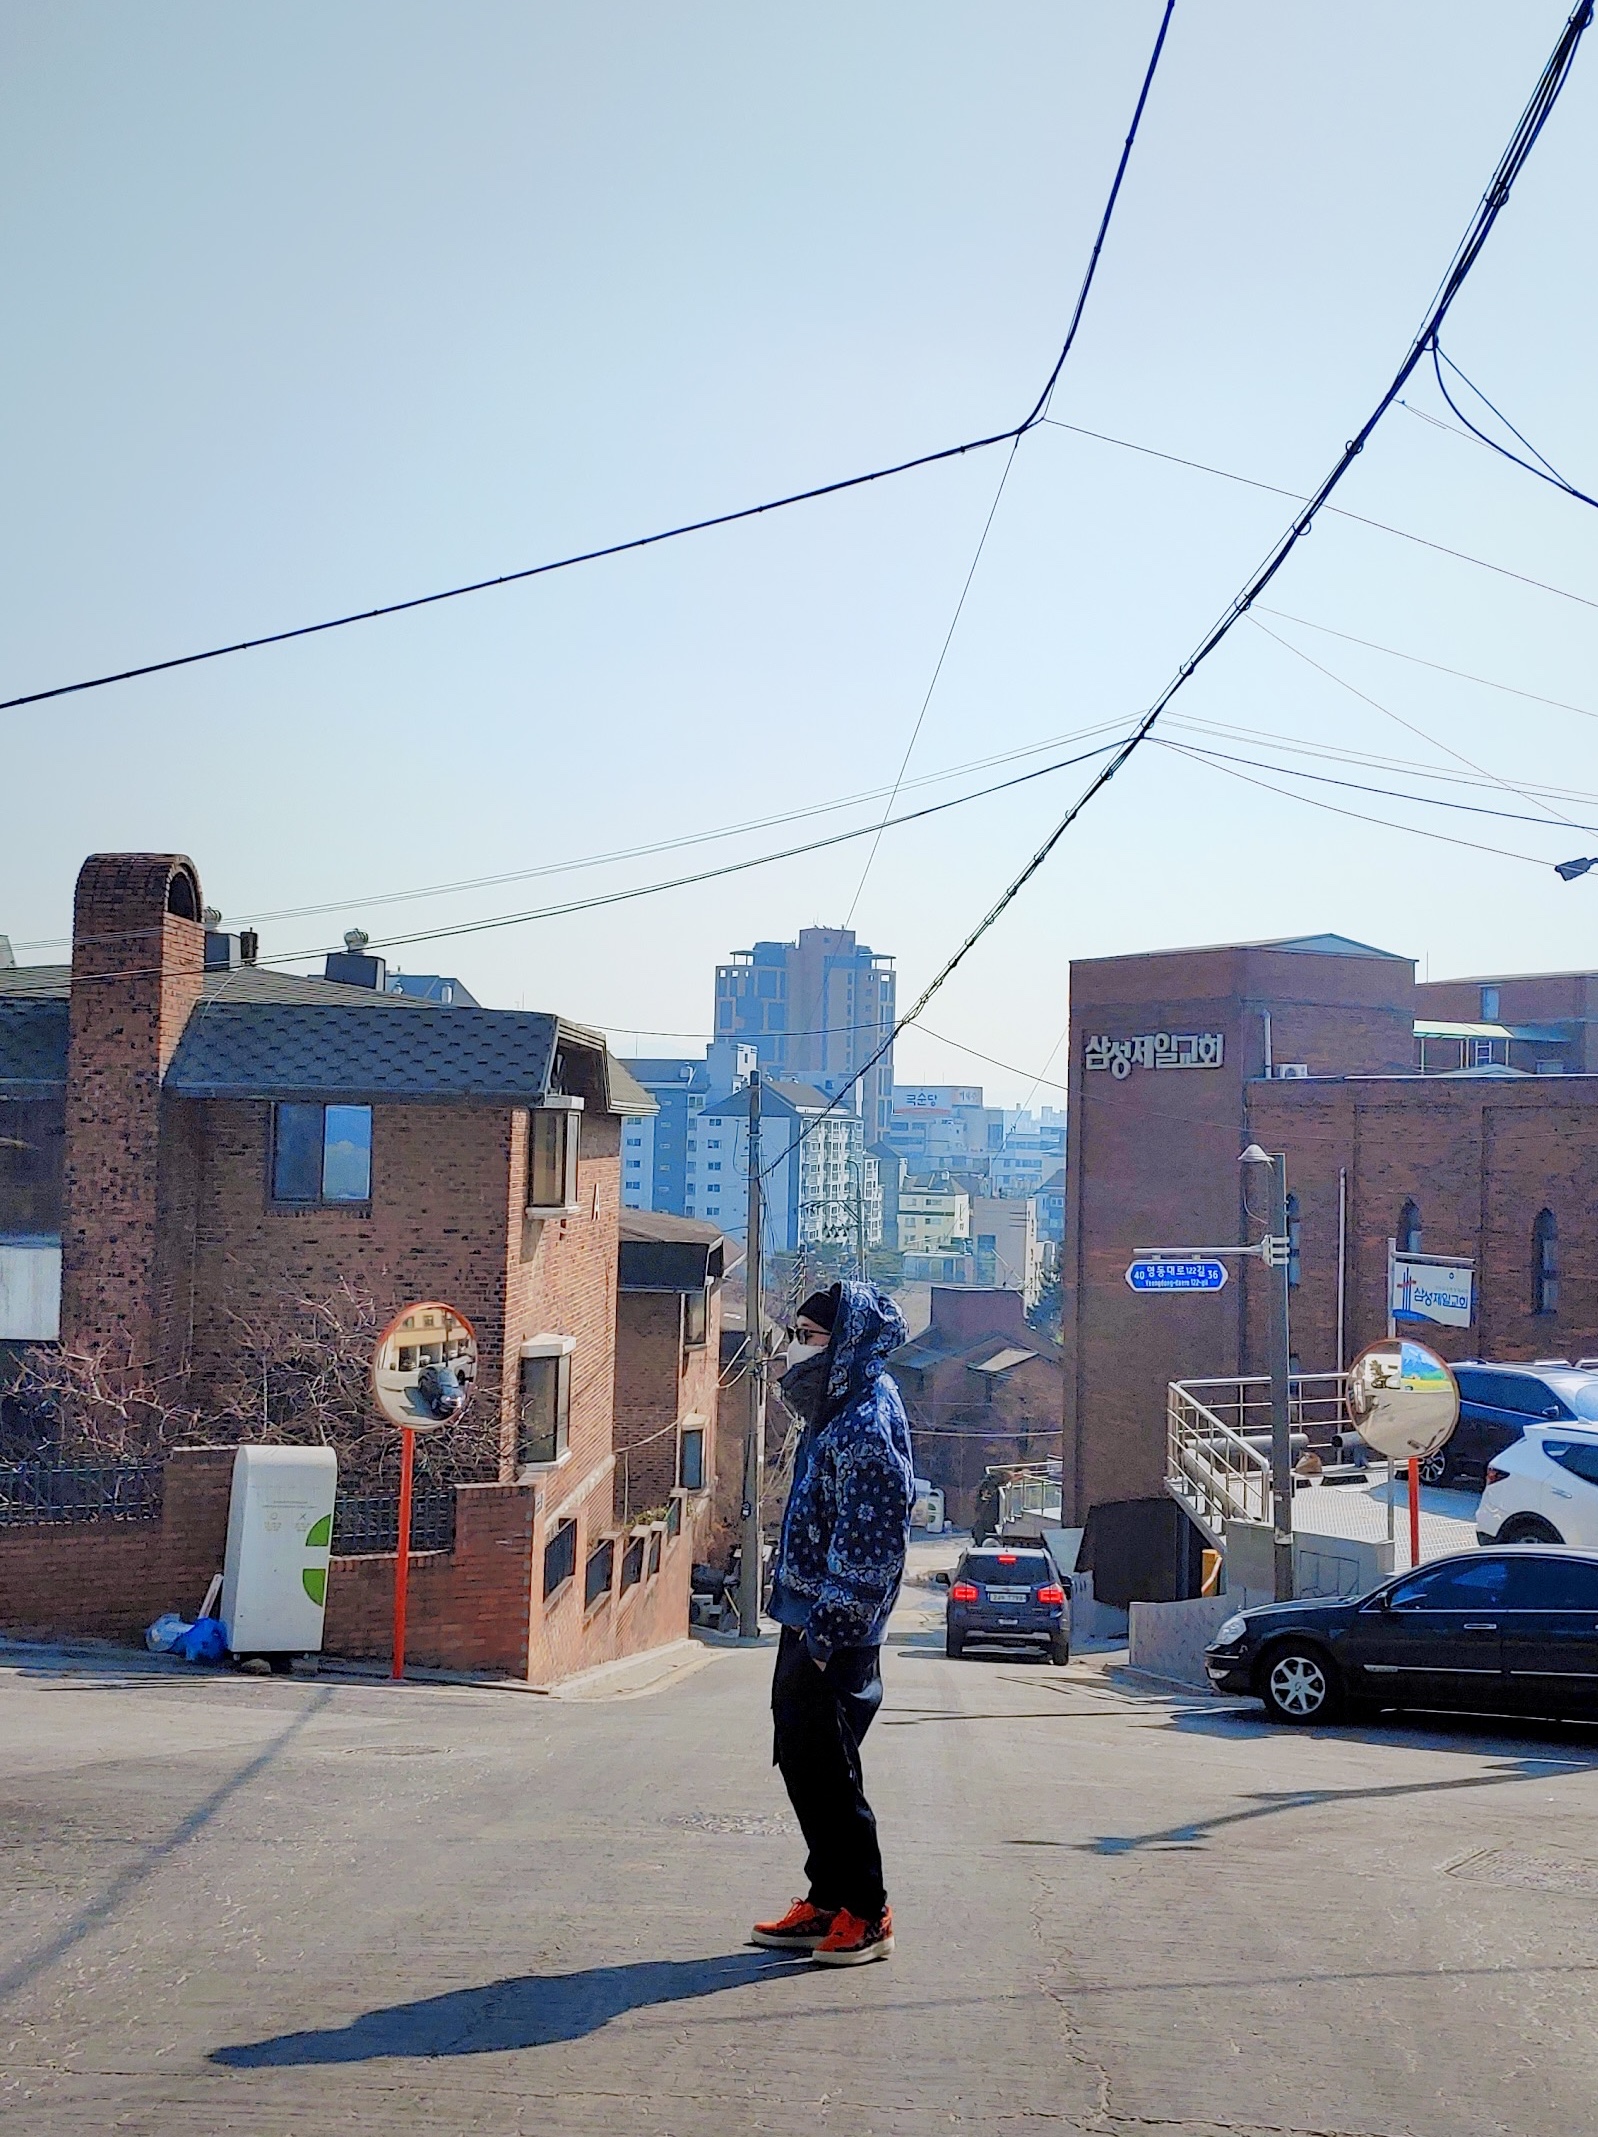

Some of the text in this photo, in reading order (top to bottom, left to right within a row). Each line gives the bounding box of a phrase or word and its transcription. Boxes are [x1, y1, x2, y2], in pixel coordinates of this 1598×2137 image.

[1085, 1033, 1224, 1080] 삼성제일교회
[1134, 1270, 1145, 1280] 40
[1207, 1269, 1219, 1279] 36
[1414, 1287, 1468, 1309] 삼성제일교회
